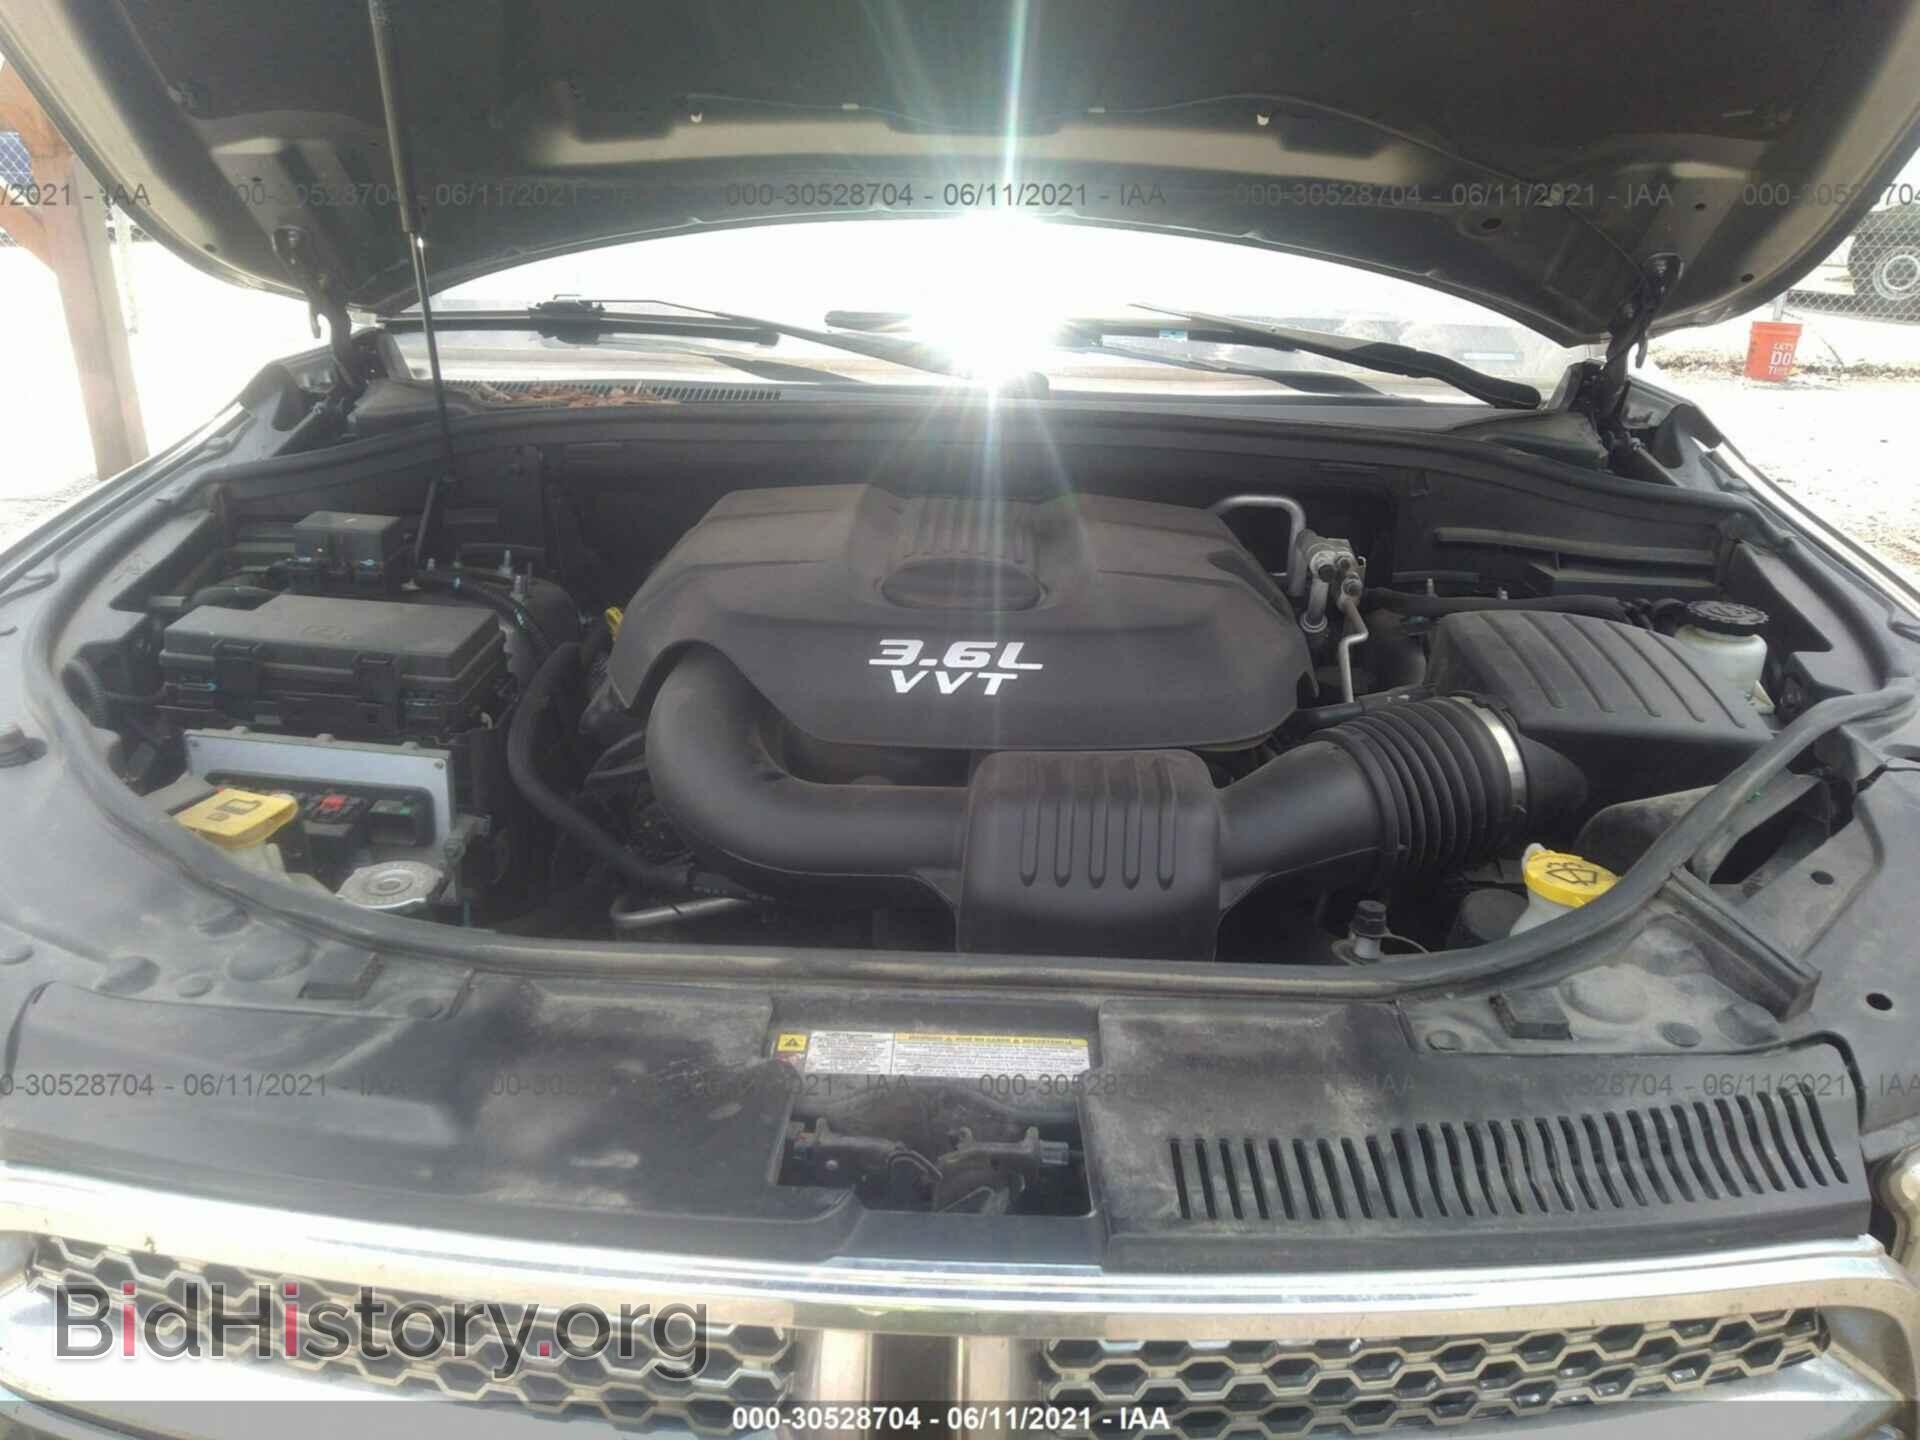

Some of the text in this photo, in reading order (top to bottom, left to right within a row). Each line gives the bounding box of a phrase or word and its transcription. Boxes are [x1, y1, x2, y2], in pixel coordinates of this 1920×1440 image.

[1770, 351, 1793, 366] DO
[868, 639, 1044, 670] 3.6L
[890, 669, 1019, 696] VVT
